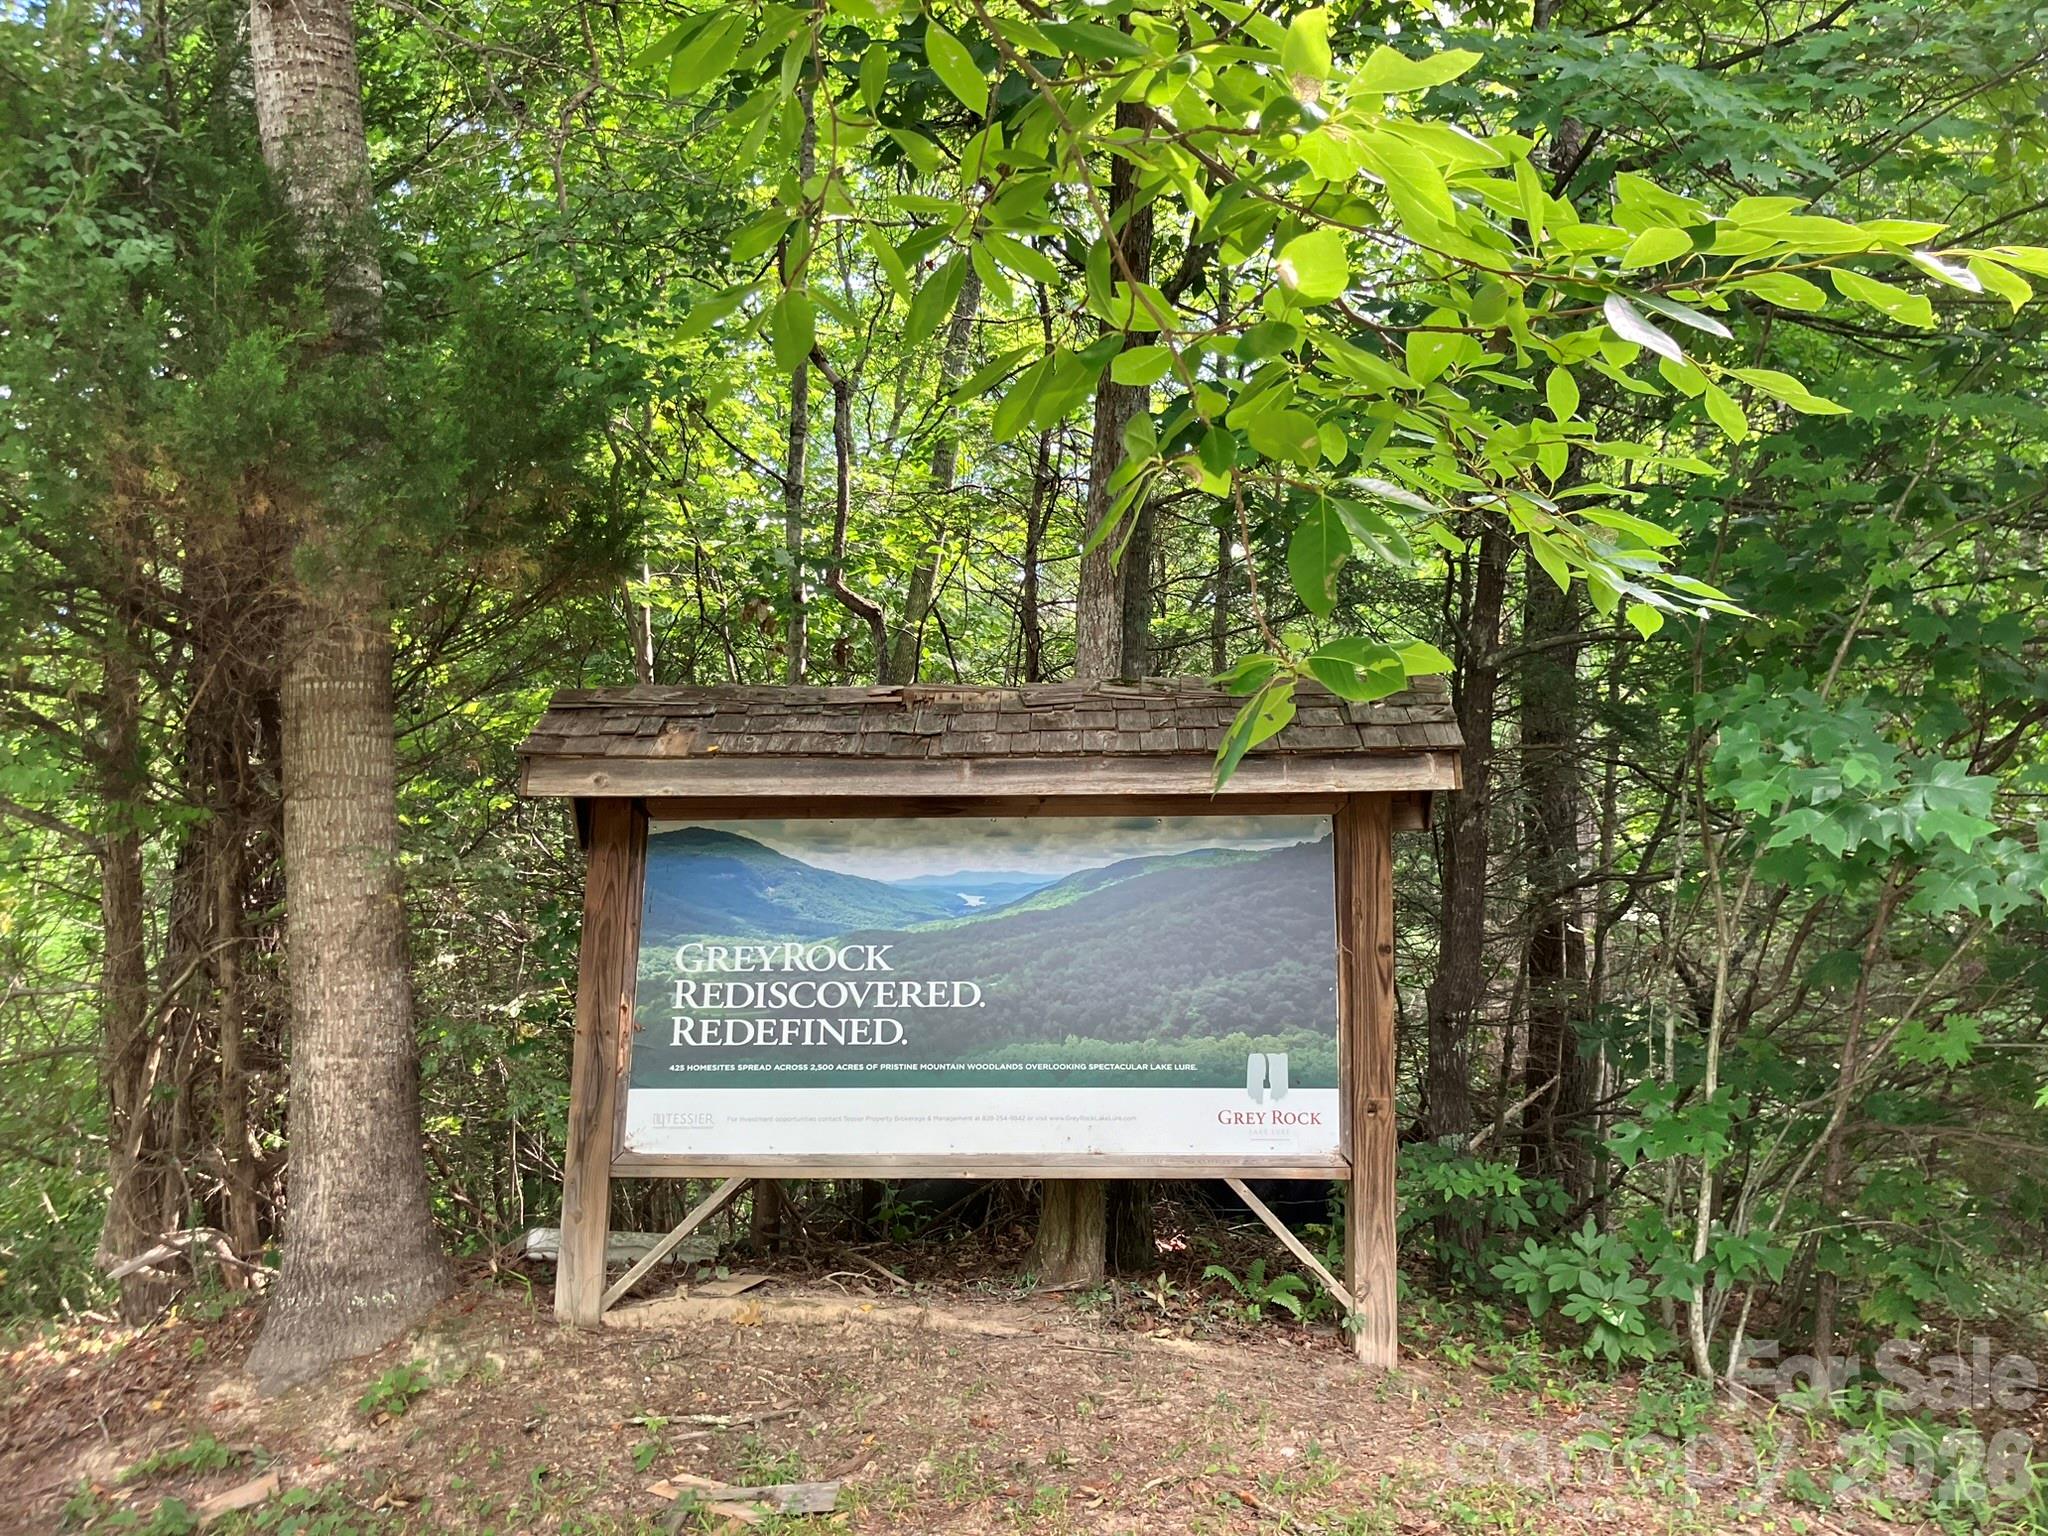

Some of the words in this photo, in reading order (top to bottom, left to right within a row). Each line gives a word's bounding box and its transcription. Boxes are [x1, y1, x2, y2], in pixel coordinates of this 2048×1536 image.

[675, 942, 894, 972] GREYROCK
[671, 979, 986, 1009] REDISCOVERED.
[669, 1016, 908, 1046] REDEFINED.
[669, 1064, 685, 1072] 425
[686, 1064, 736, 1072] HOMESITES
[737, 1064, 771, 1072] SPREAD
[773, 1064, 808, 1072] ACROSS
[810, 1064, 834, 1072] 2,500
[666, 1112, 714, 1125] TESSIER
[1217, 1109, 1266, 1125] GREY
[1272, 1109, 1323, 1125] ROCK
